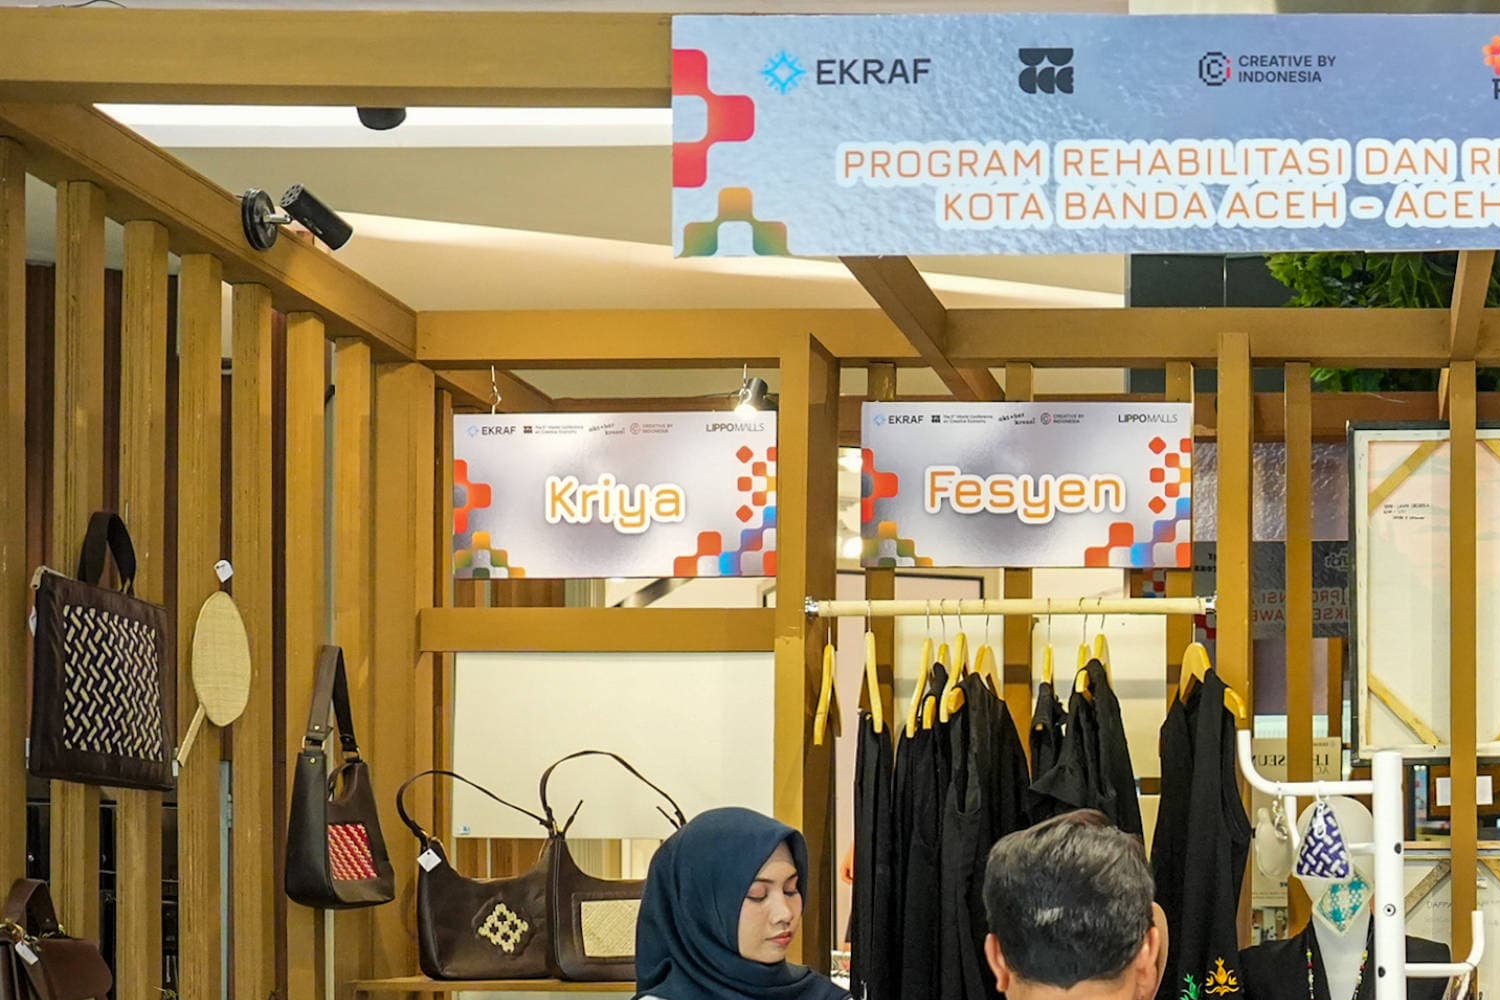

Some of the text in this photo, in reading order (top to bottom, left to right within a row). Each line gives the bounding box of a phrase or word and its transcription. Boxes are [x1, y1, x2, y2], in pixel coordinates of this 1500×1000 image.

[816, 58, 932, 85] EKRAF
[1238, 55, 1336, 68] CREATIVE BY
[1238, 71, 1322, 84] INDONESIA
[843, 147, 1042, 178] PROGRAM
[1063, 146, 1343, 177] REHABILITASI
[1364, 146, 1449, 176] DAN
[944, 192, 1046, 220] KOTA
[1064, 191, 1208, 220] BANDA
[1226, 190, 1338, 219] ACEH
[481, 425, 516, 436] EKRAF
[888, 414, 924, 424] EKRAF
[550, 479, 682, 528] Kriya
[929, 470, 1121, 519] Fesyen
